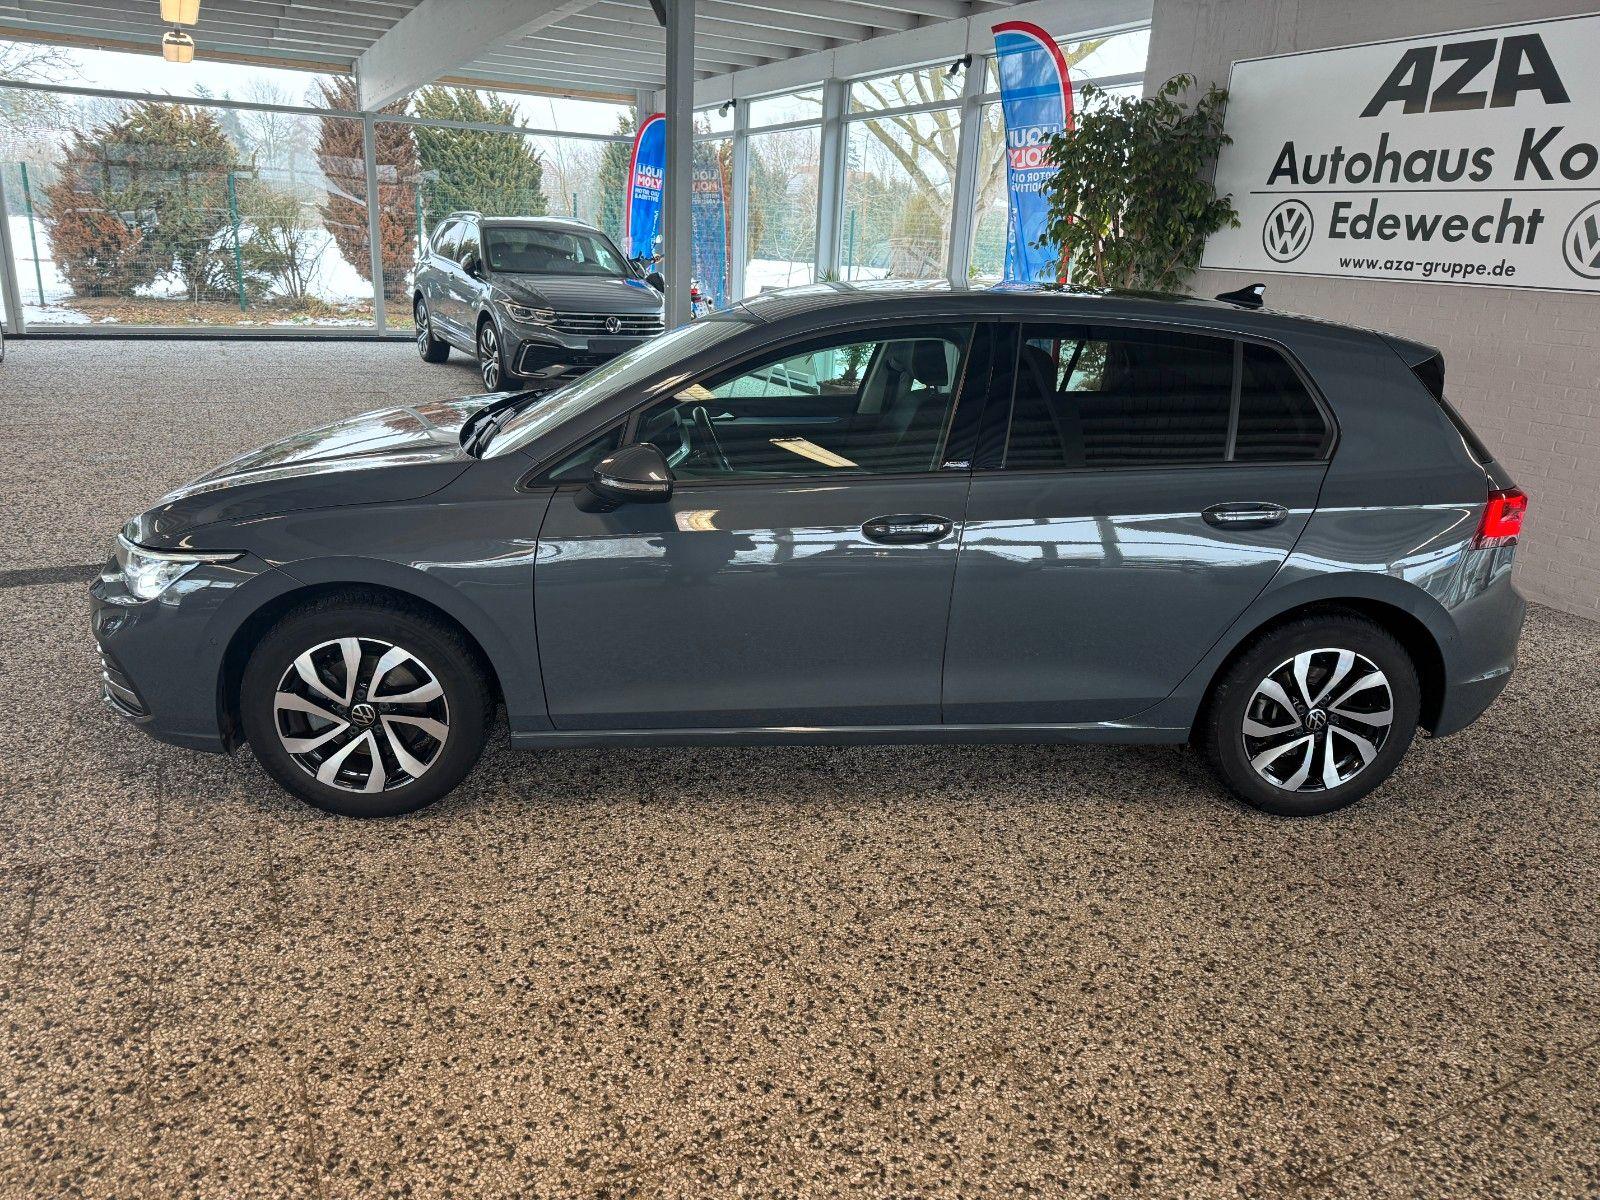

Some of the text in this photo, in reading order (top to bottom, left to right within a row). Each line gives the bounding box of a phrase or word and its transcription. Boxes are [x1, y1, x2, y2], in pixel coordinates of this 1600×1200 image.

[1359, 33, 1571, 118] AZA
[637, 164, 663, 179] LIQUI
[1266, 126, 1598, 185] Autohaus Ko
[637, 174, 662, 189] MOLY
[1329, 198, 1544, 244] Edewecht
[1339, 256, 1516, 279] www.aza-gruppe.de
